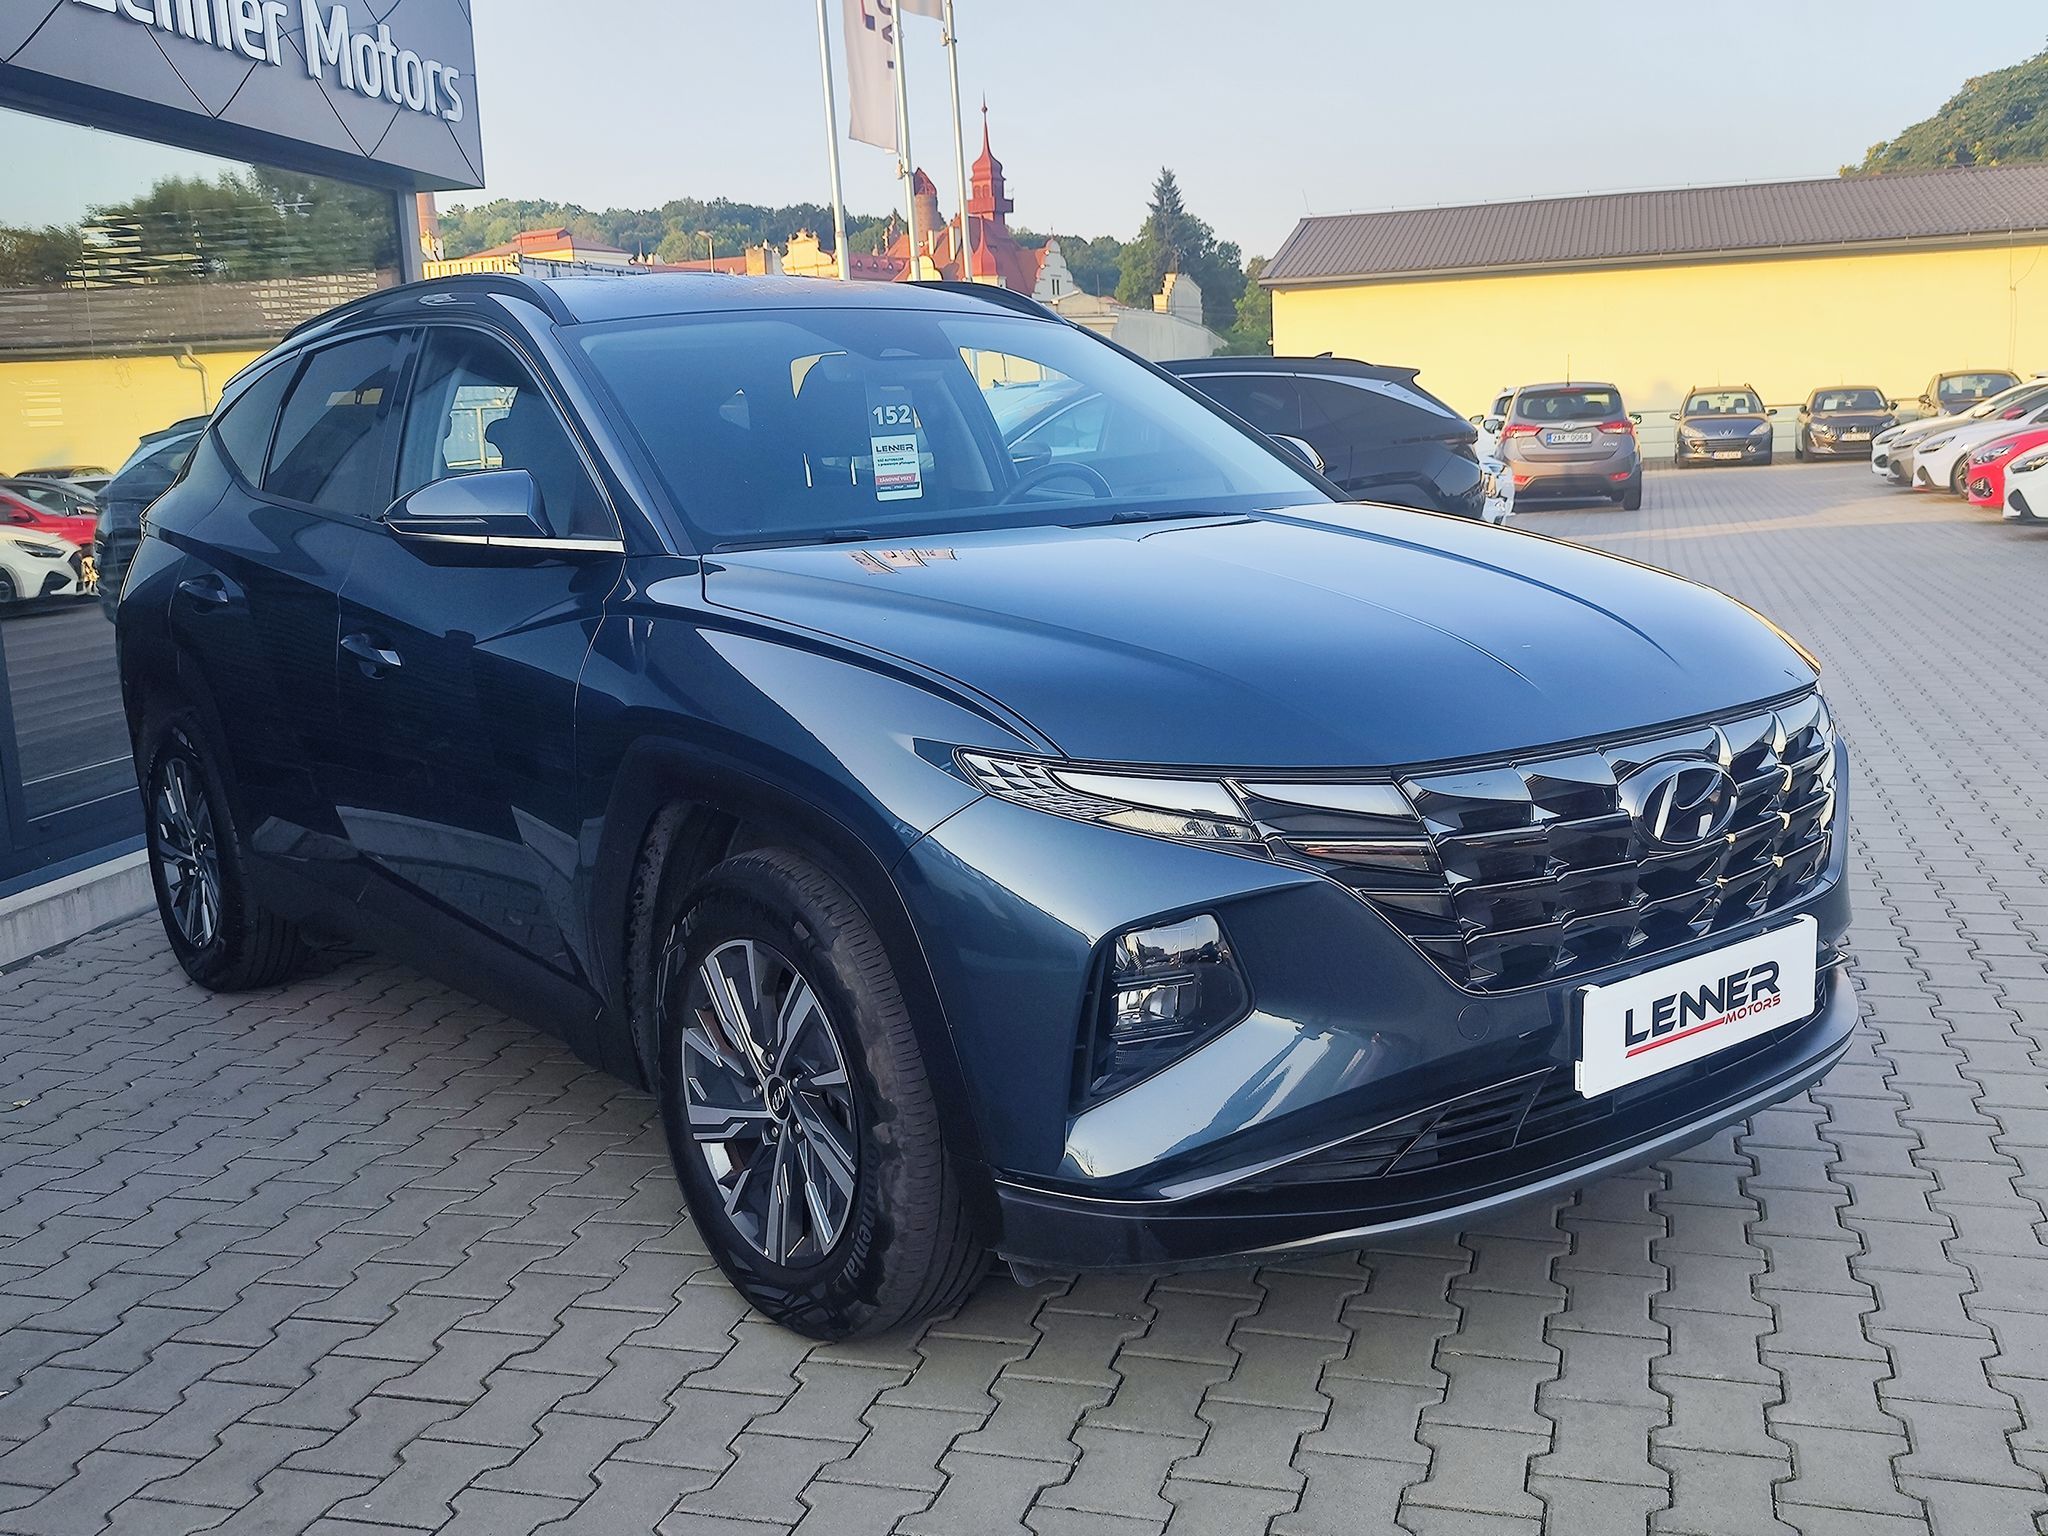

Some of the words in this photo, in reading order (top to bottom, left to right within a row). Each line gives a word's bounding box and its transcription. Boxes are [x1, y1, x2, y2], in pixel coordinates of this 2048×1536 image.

[73, 0, 287, 67] nner
[305, 4, 464, 122] Motors
[872, 404, 911, 425] 152
[876, 443, 914, 452] LENNER
[1625, 961, 1781, 1048] LENNER
[1724, 994, 1781, 1025] MOTORS
